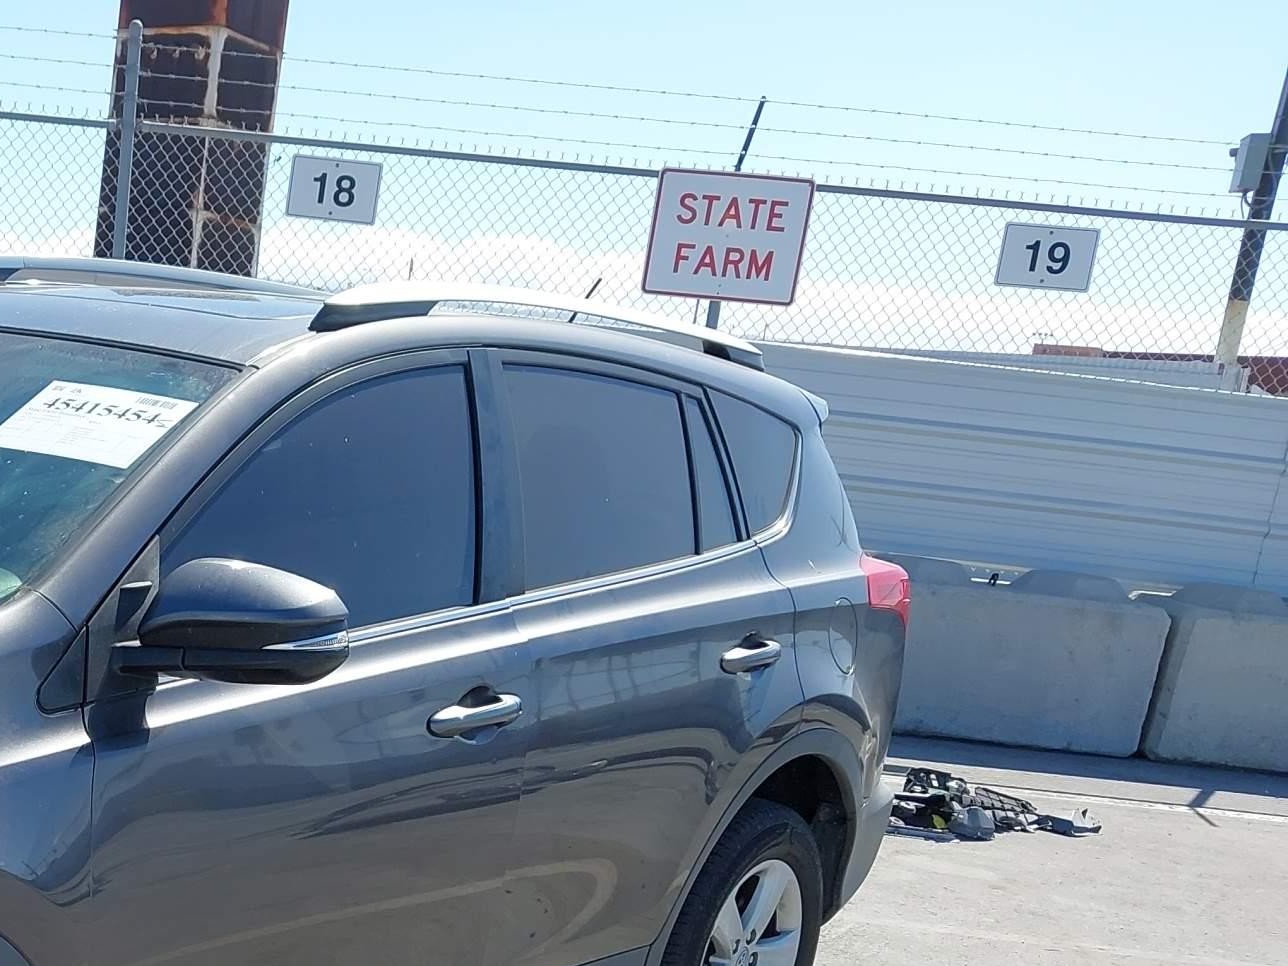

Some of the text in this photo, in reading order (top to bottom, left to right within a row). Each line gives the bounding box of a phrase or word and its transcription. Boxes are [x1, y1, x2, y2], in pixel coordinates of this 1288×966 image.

[313, 172, 356, 207] 18
[676, 192, 789, 232] STATE
[673, 242, 774, 281] FARM
[1025, 240, 1071, 274] 19
